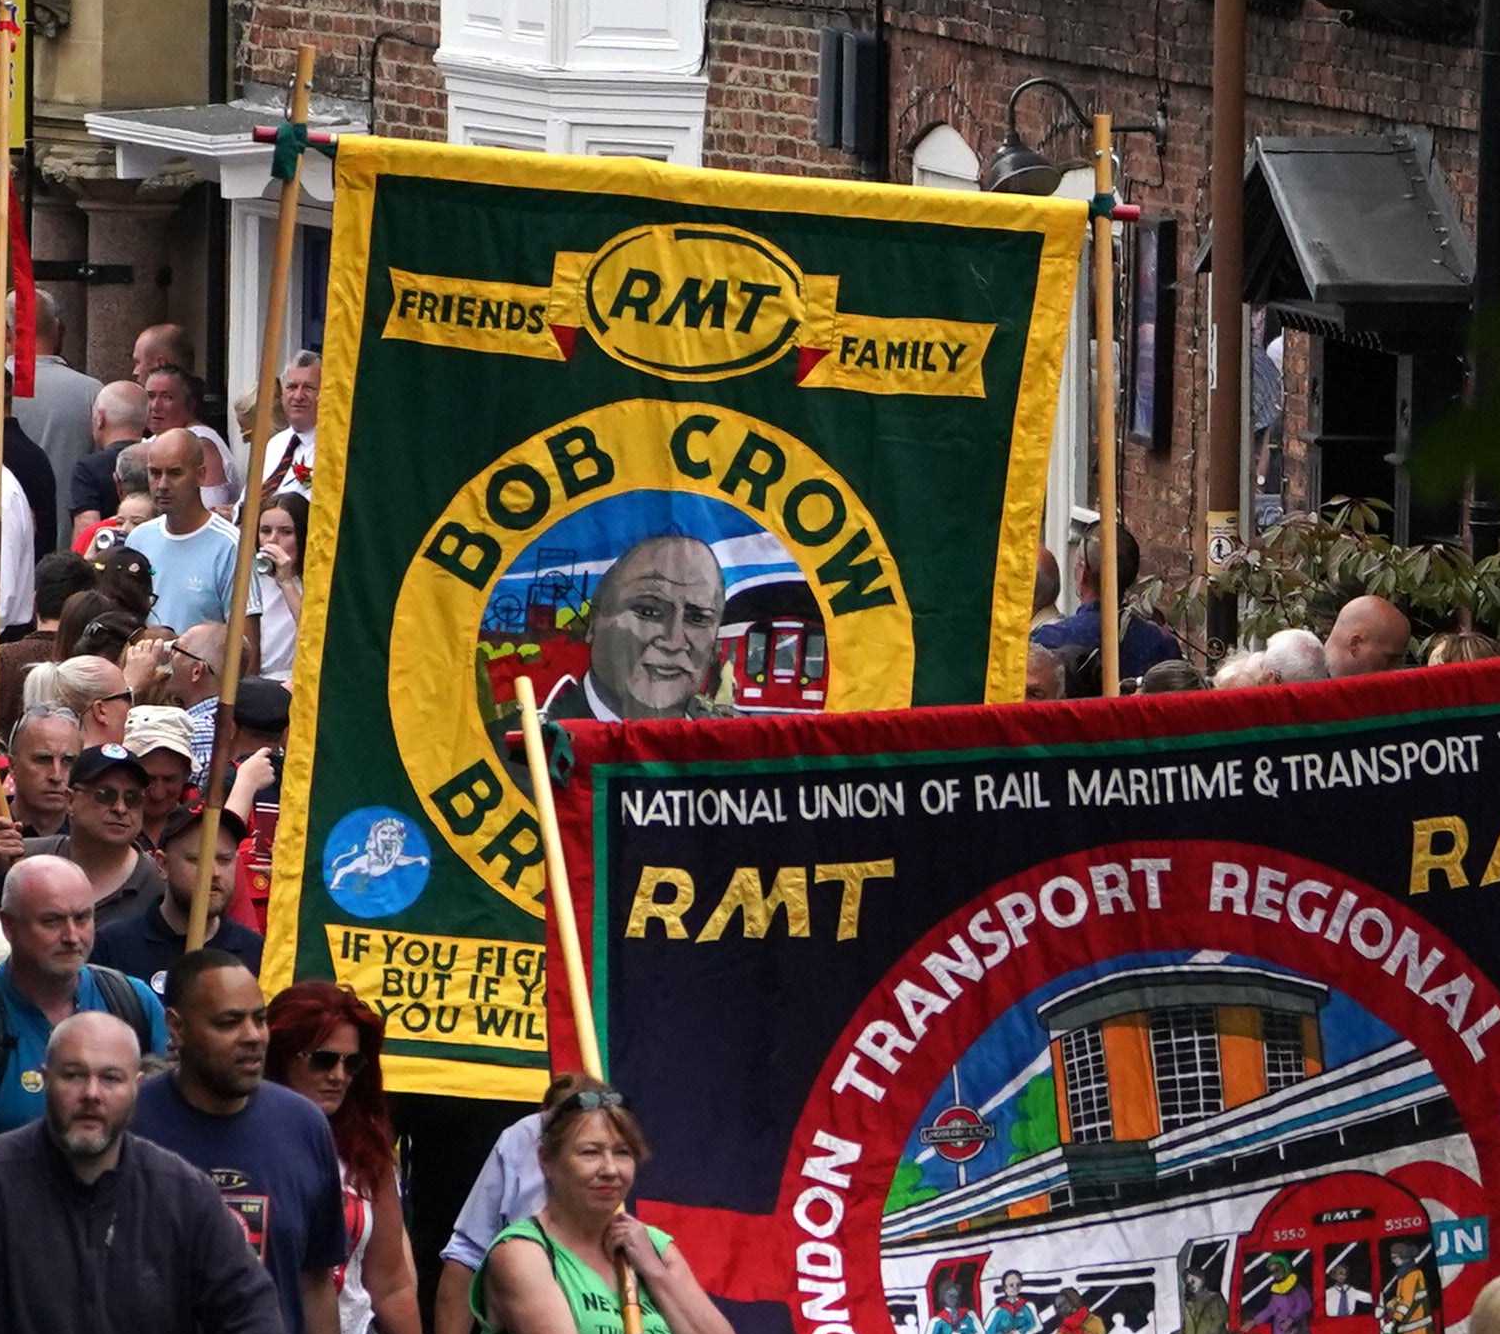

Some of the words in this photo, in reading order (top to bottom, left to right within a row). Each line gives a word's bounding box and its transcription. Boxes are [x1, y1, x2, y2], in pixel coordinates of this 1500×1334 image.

[397, 288, 547, 334] FRIENDS
[608, 268, 783, 334] RMT
[839, 336, 969, 373] FAMILY
[424, 426, 615, 592] BOB
[670, 414, 897, 618] CROW
[621, 787, 788, 828] NATIONAL
[799, 781, 905, 819] UNION
[921, 778, 961, 815] OF
[975, 771, 1050, 812] RAIL
[1067, 759, 1243, 807] MARITIME
[1281, 733, 1484, 791] TRANSPORT
[624, 858, 896, 943] RMT
[341, 931, 370, 963] IF
[382, 934, 459, 971] YOU
[382, 968, 453, 1000] BUT
[469, 975, 500, 1003] IF
[831, 857, 1171, 1103] TRANSPORT
[375, 1000, 460, 1033] YOU
[1322, 1210, 1361, 1222] RMT
